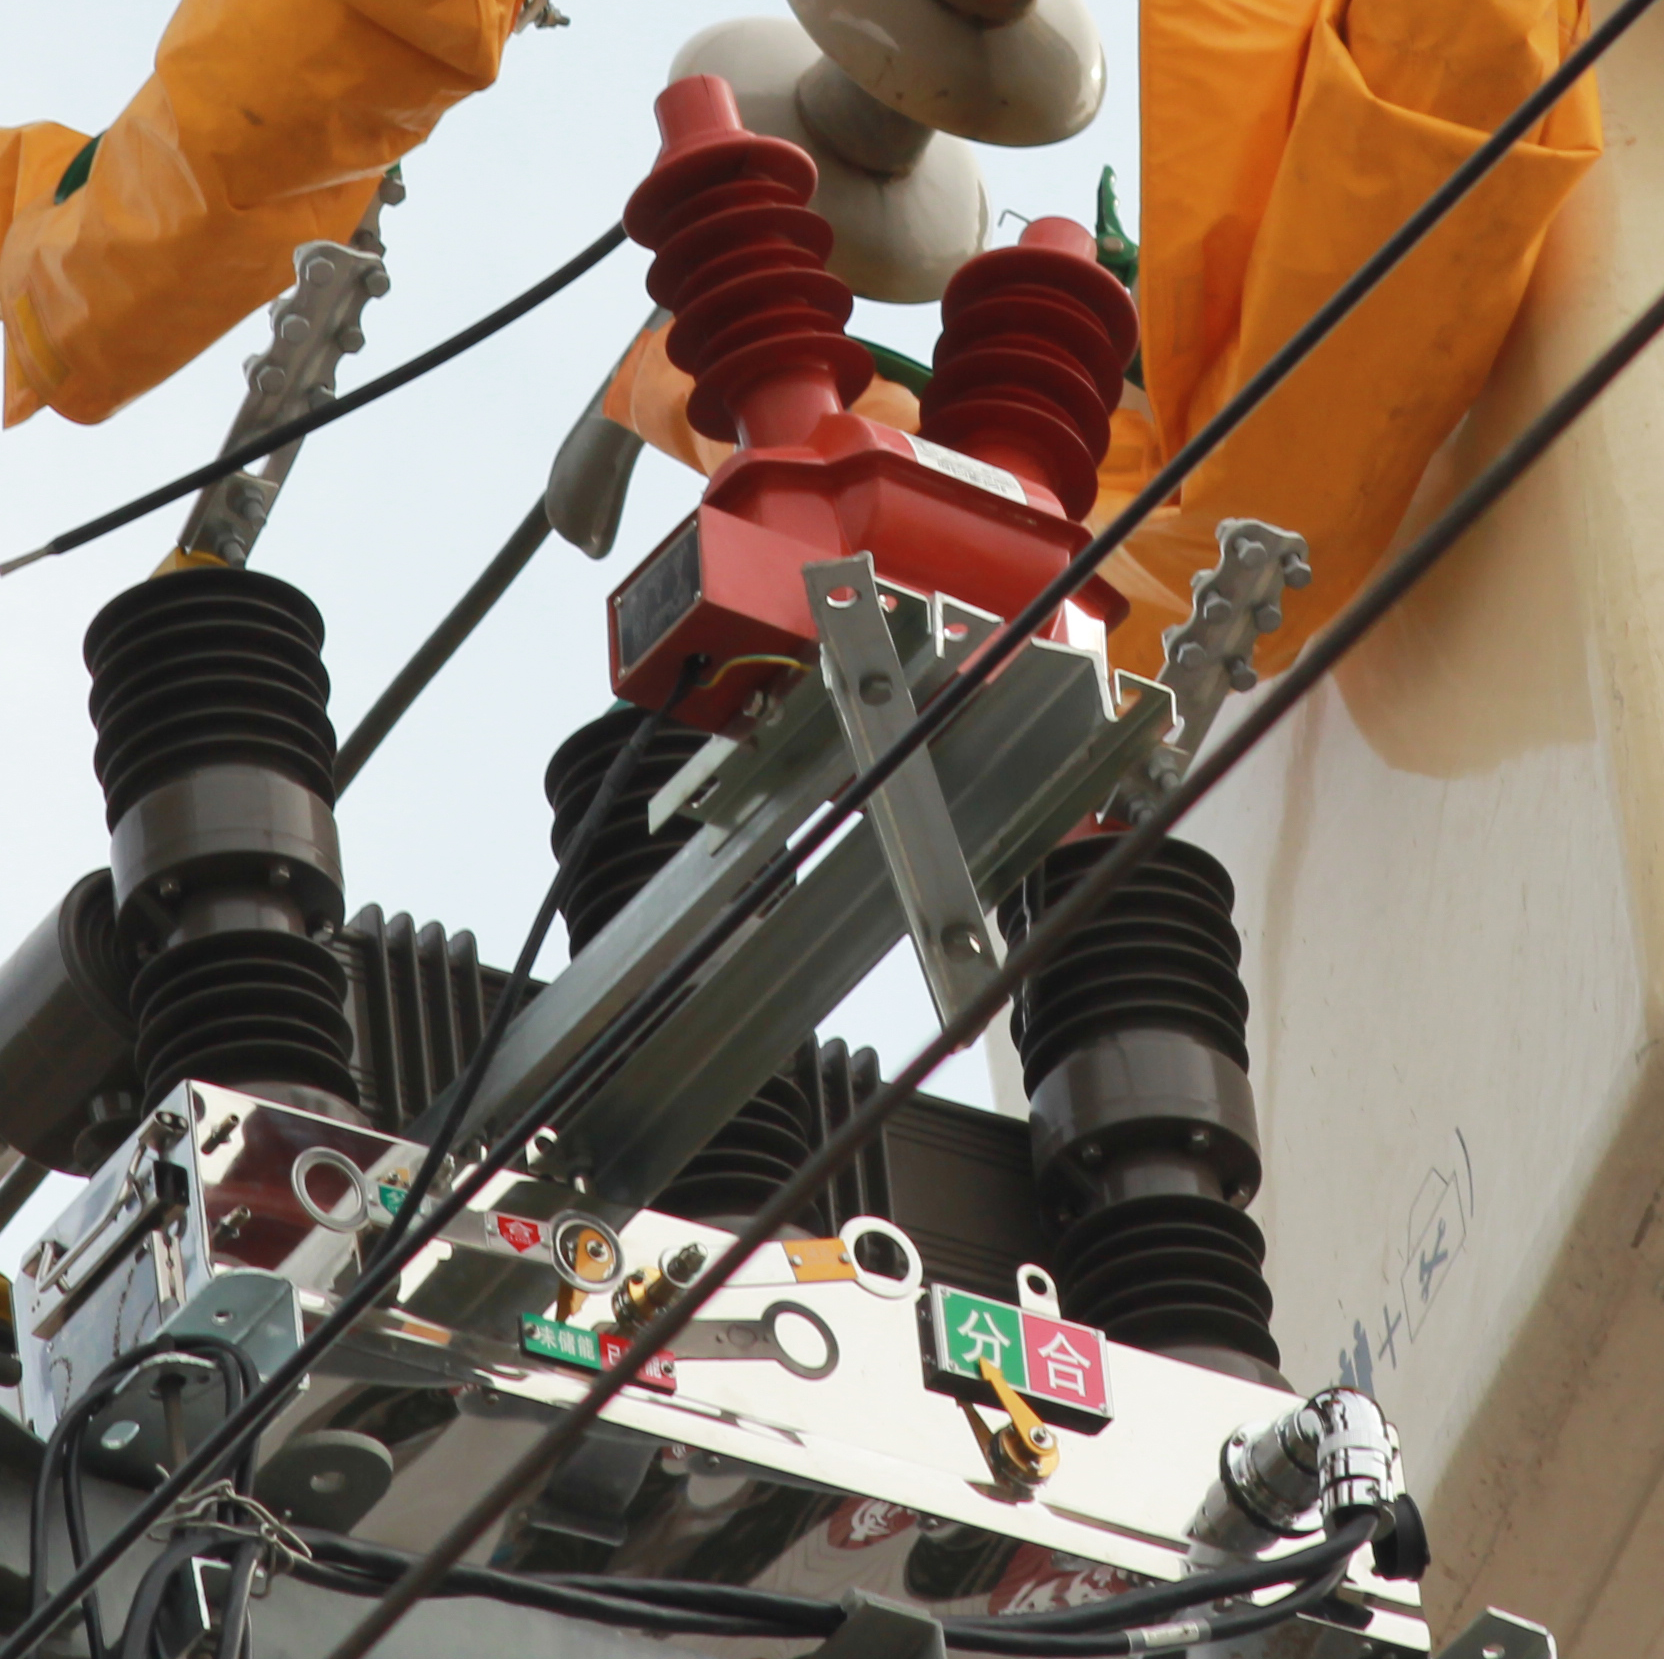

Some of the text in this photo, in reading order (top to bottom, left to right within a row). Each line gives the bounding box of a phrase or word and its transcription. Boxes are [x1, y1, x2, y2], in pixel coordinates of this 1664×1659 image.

[540, 1325, 662, 1379] 未储能 已能
[957, 1309, 1091, 1398] 分 合
